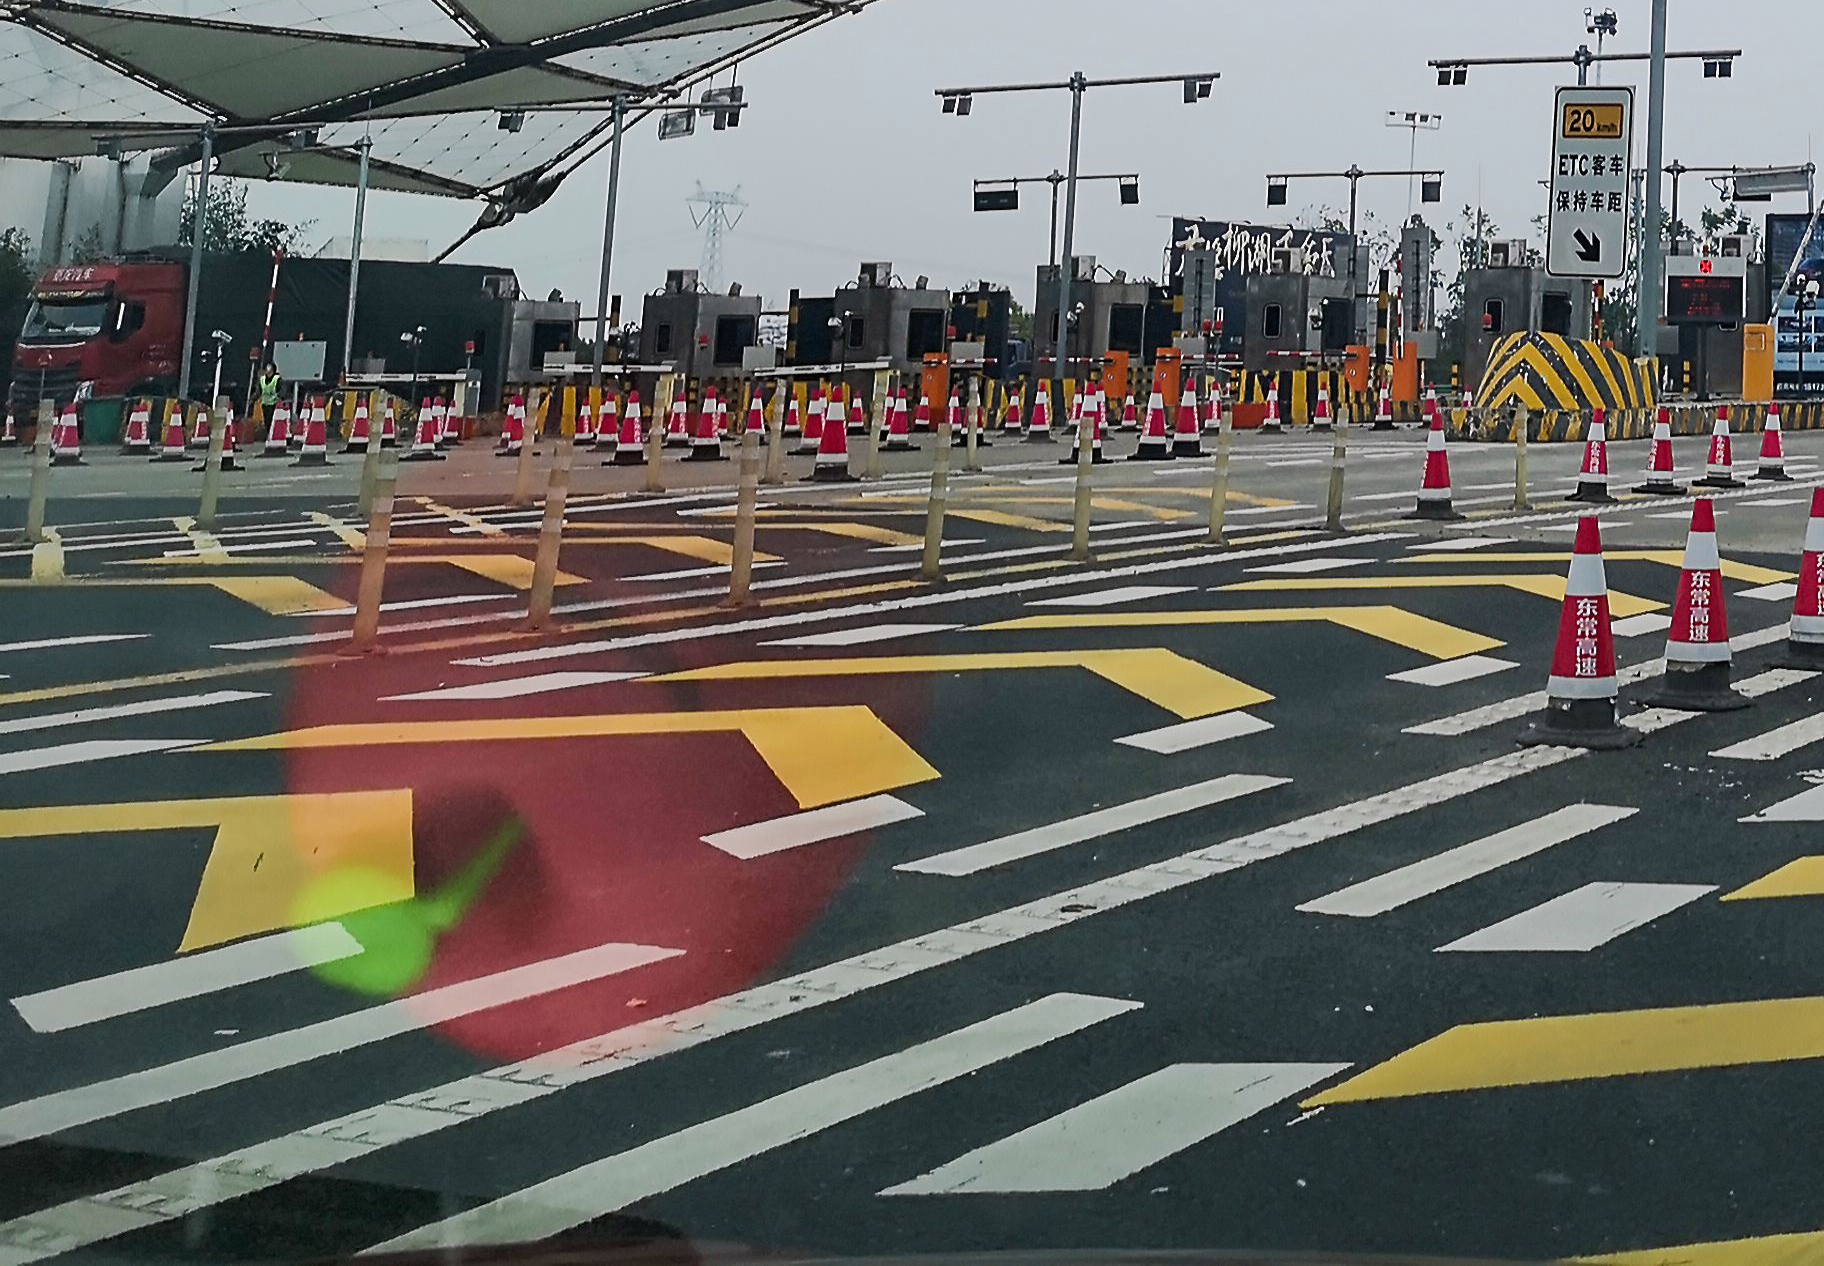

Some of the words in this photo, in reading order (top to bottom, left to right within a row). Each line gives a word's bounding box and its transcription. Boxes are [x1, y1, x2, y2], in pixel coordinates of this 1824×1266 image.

[1569, 109, 1595, 133] 20
[1556, 190, 1623, 213] 保持车距
[1688, 570, 1711, 642] 东常高速
[1575, 597, 1599, 677] 东常高速
